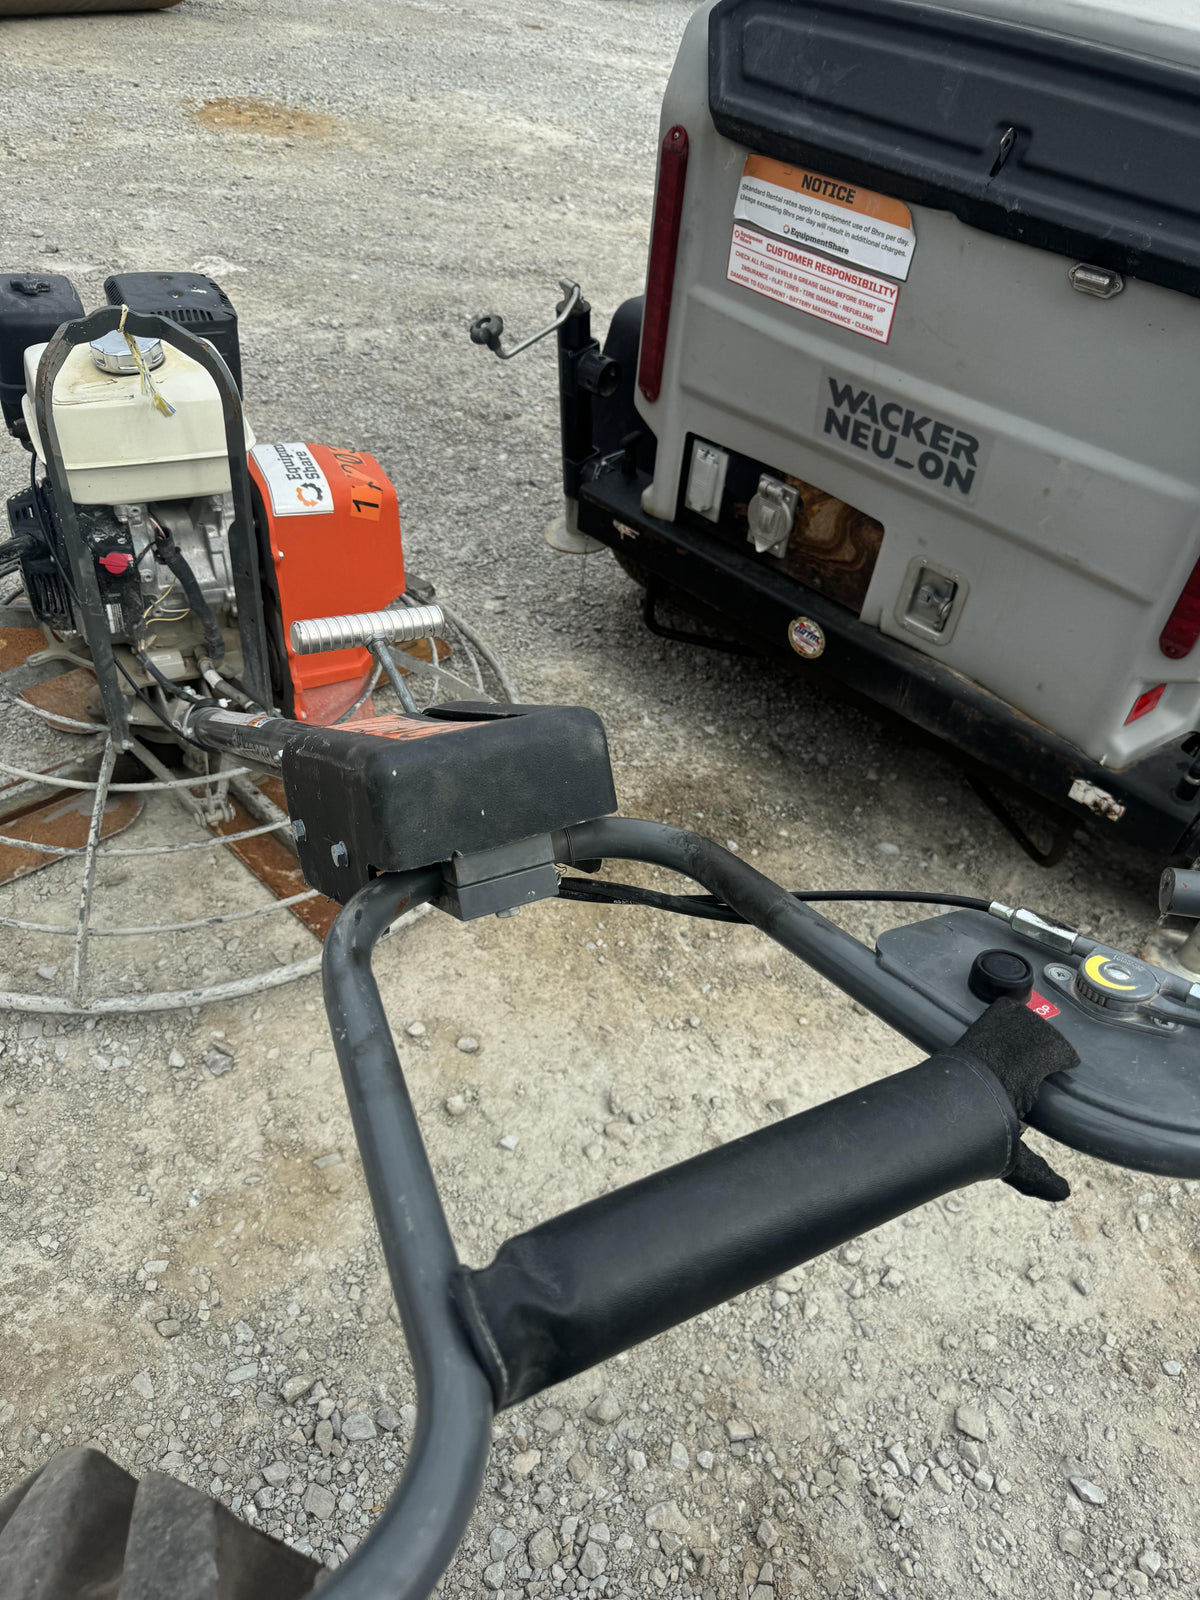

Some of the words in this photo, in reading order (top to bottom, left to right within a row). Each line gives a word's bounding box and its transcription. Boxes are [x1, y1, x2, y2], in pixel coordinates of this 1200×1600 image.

[742, 184, 765, 196] Standard
[766, 192, 783, 202] Rental
[784, 199, 797, 208] rates
[798, 204, 813, 214] apply
[814, 208, 820, 216] to
[821, 212, 851, 226] equipment
[852, 222, 862, 230] use
[897, 237, 910, 247] day.
[801, 174, 856, 204] NOTICE
[740, 194, 756, 204] Usage
[756, 201, 782, 215] exceeding
[806, 217, 816, 226] day
[817, 221, 826, 229] will
[827, 226, 844, 236] result
[851, 234, 881, 248] additional
[881, 243, 906, 257] charges.
[790, 227, 849, 255] EquipmentShare
[735, 251, 750, 261] CHECK
[751, 257, 759, 265] ALL
[760, 261, 774, 272] FLUID
[775, 267, 792, 279] LEVELS
[798, 276, 818, 289] GREASE
[819, 284, 835, 295] DAILY
[836, 290, 857, 303] BEFORE
[858, 298, 877, 310] START
[741, 264, 768, 280] INSURANCE
[771, 277, 782, 286] FLAT
[784, 282, 799, 292] TIRES
[803, 289, 815, 299] TIRE
[816, 295, 838, 308] DAMAGE
[842, 304, 873, 321] REFUELING
[766, 243, 813, 268] CUSTOMER
[815, 261, 896, 298] RESPONSIBILITY
[730, 270, 750, 283] DAMAGE
[757, 281, 785, 299] EQUIPMENT
[789, 296, 811, 308] BATTERY
[812, 304, 850, 324] MAINTENANCE
[854, 321, 884, 337] CLEANING
[824, 408, 976, 495] NEUON
[829, 376, 979, 468] WACKER
[296, 451, 320, 480] Share
